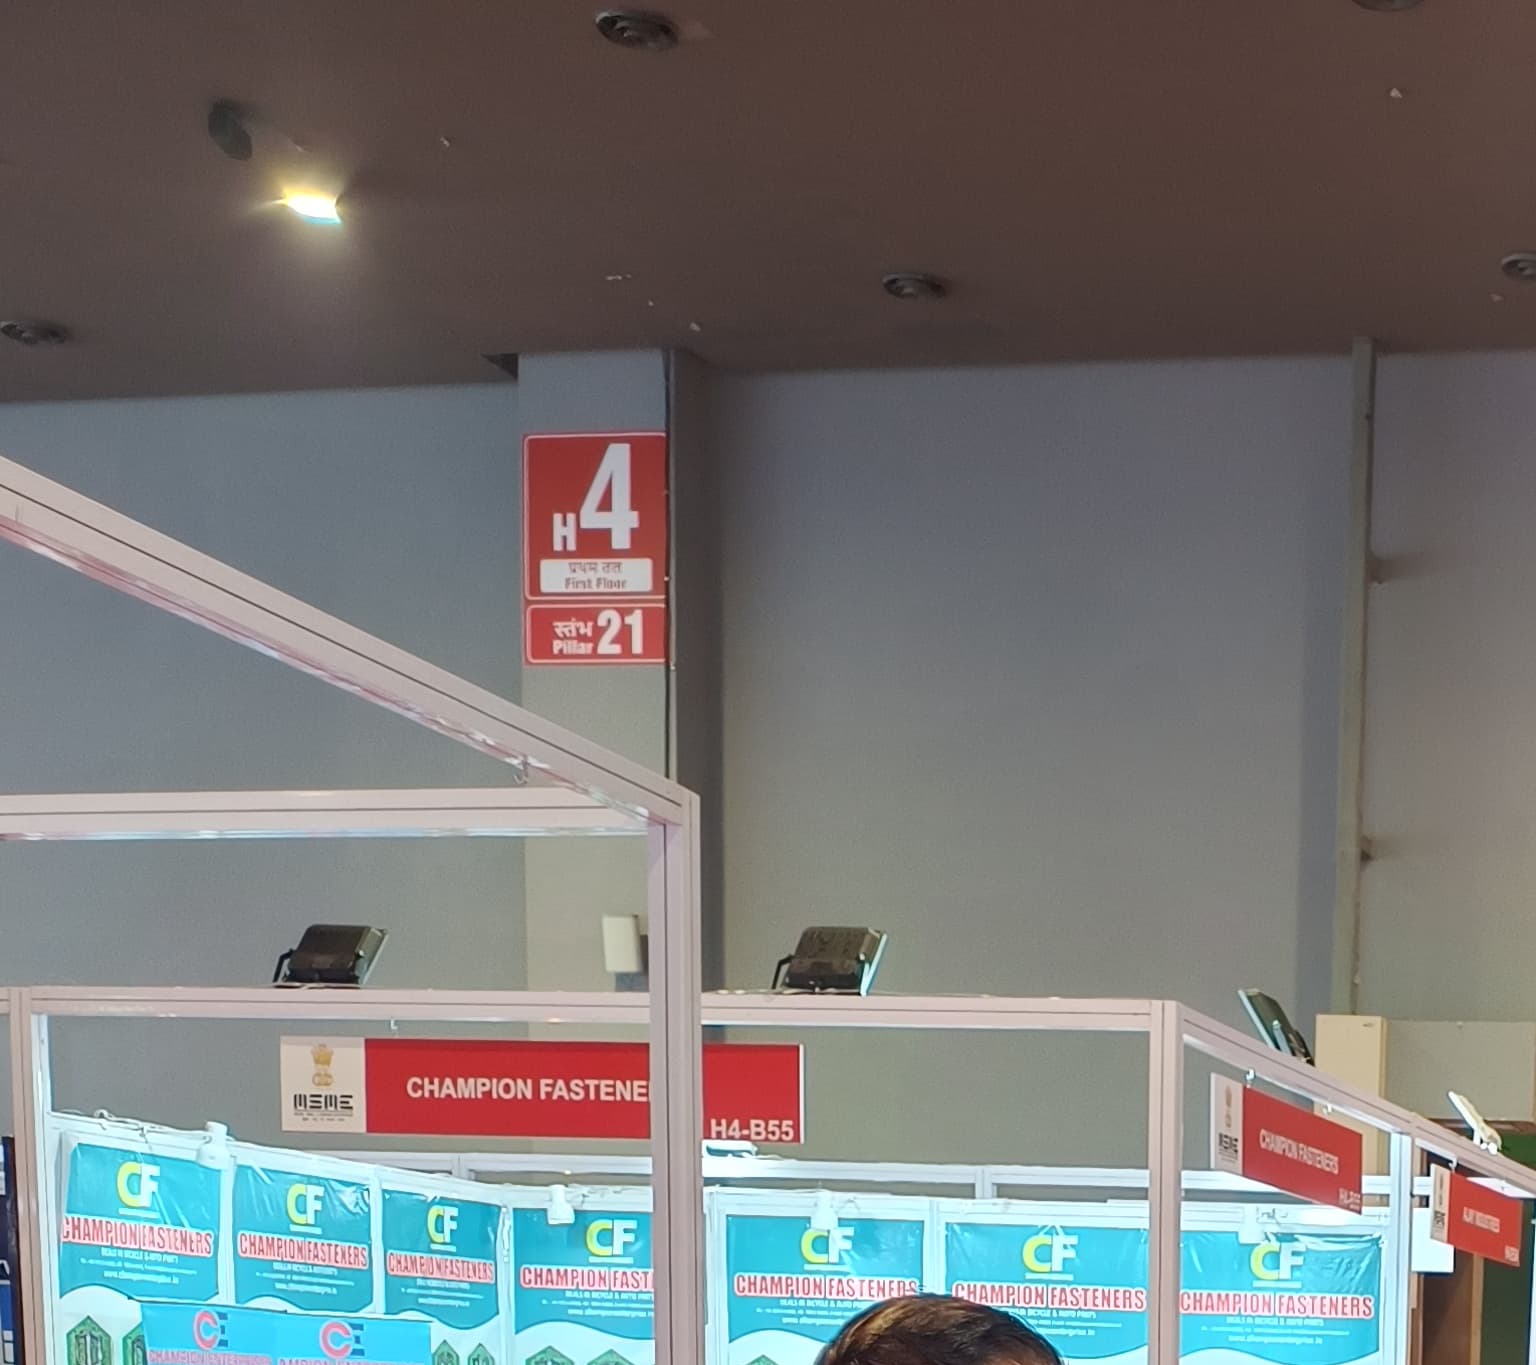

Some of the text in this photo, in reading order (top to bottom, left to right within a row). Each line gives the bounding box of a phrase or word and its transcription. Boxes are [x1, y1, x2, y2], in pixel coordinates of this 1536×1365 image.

[565, 577, 627, 589] First Floor
[552, 617, 594, 638] स्तंभ
[552, 609, 643, 655] Pillar 21
[407, 1076, 650, 1102] CHAMPION FASTENE
[710, 1118, 794, 1141] H4-B55
[117, 1161, 160, 1208] CF
[287, 1183, 325, 1225] CF
[63, 1216, 213, 1255] CHAMPION FASTENERS
[427, 1205, 458, 1243] CF
[585, 1219, 638, 1257] CF
[240, 1233, 367, 1267] CHAMPION FASTENERS
[801, 1227, 854, 1265] CF
[1022, 1234, 1079, 1273] CF
[1250, 1243, 1306, 1281] CF
[613, 1270, 650, 1289] FAST
[954, 1283, 1145, 1309] CHAMPION FASTENERS
[1180, 1291, 1372, 1317] CHAMPION FASTENERS
